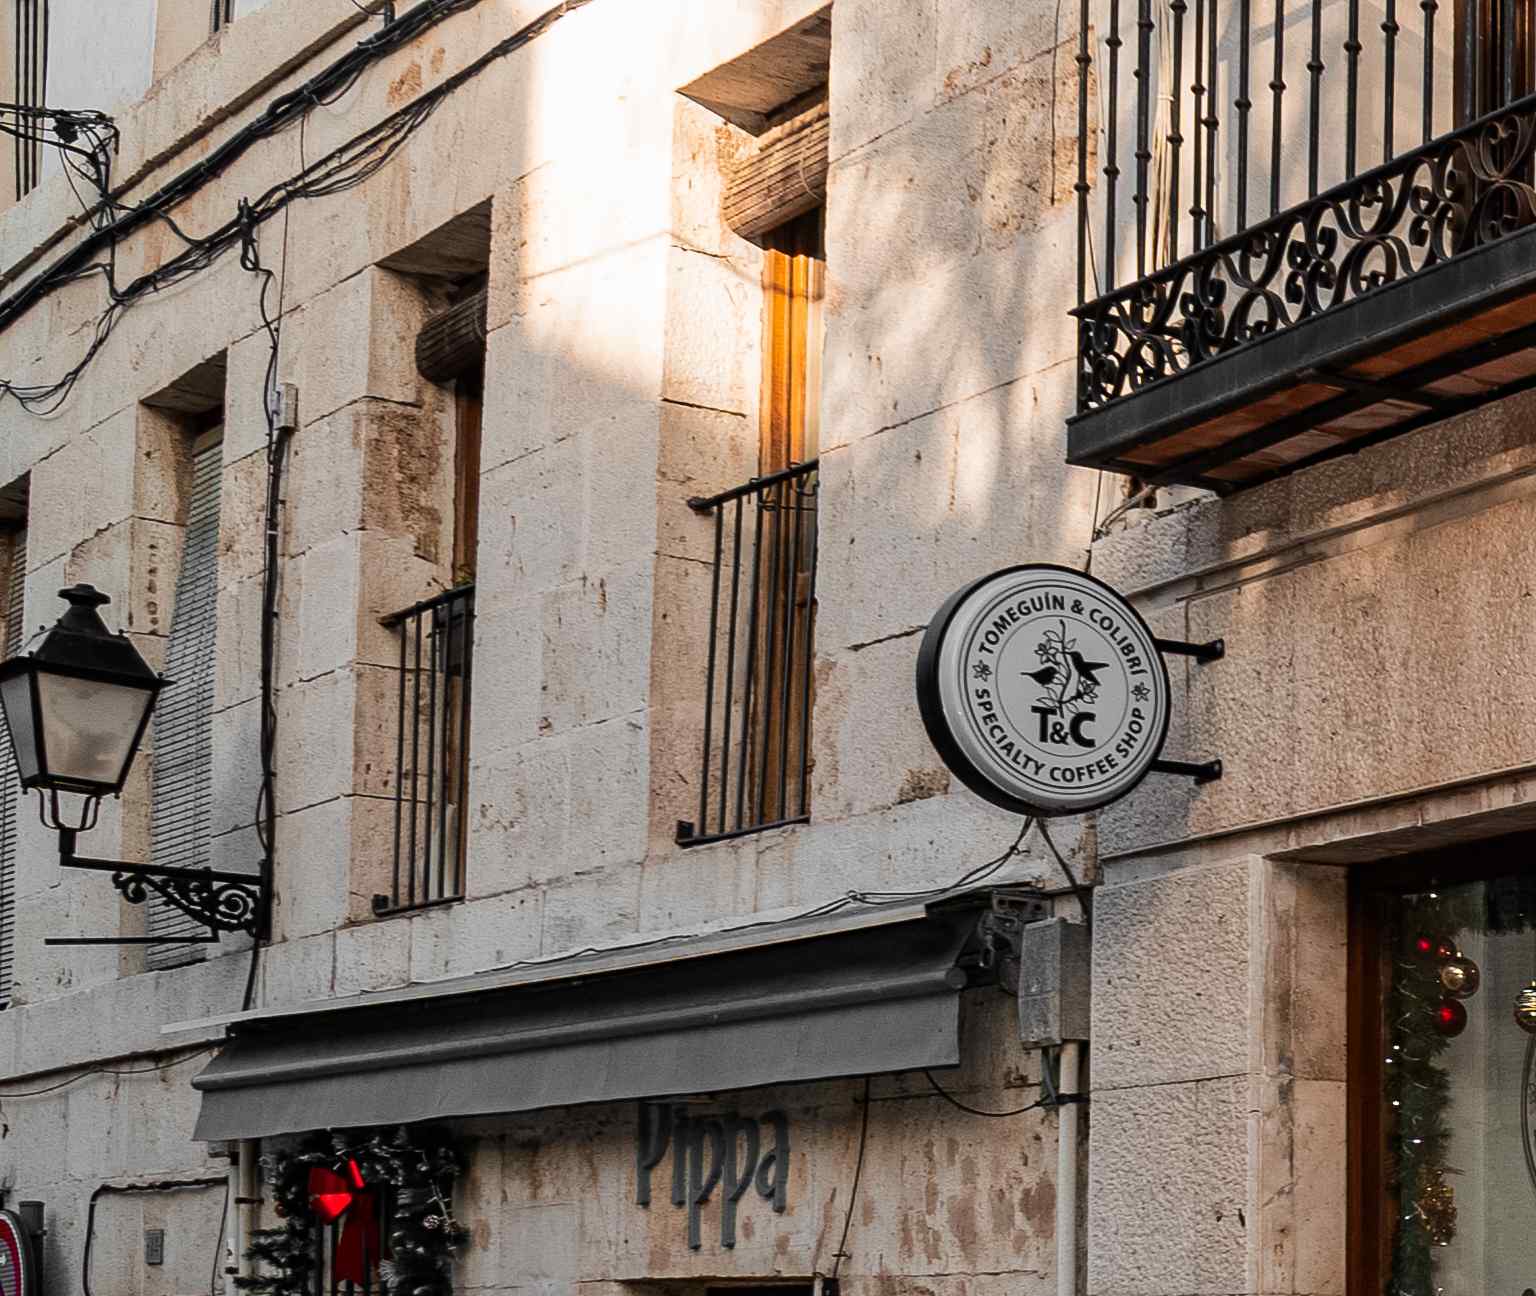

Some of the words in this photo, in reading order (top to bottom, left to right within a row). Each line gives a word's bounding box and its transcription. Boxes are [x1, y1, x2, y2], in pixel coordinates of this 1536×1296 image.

[979, 592, 1065, 655] TOMEGUÍN
[1071, 599, 1084, 614] &
[1089, 608, 1148, 675] COLIBRÍ
[975, 688, 1046, 776] SPECIALTY
[1049, 755, 1119, 783] COFFEE
[1118, 707, 1145, 758] SHOP
[1031, 705, 1097, 748] T&C
